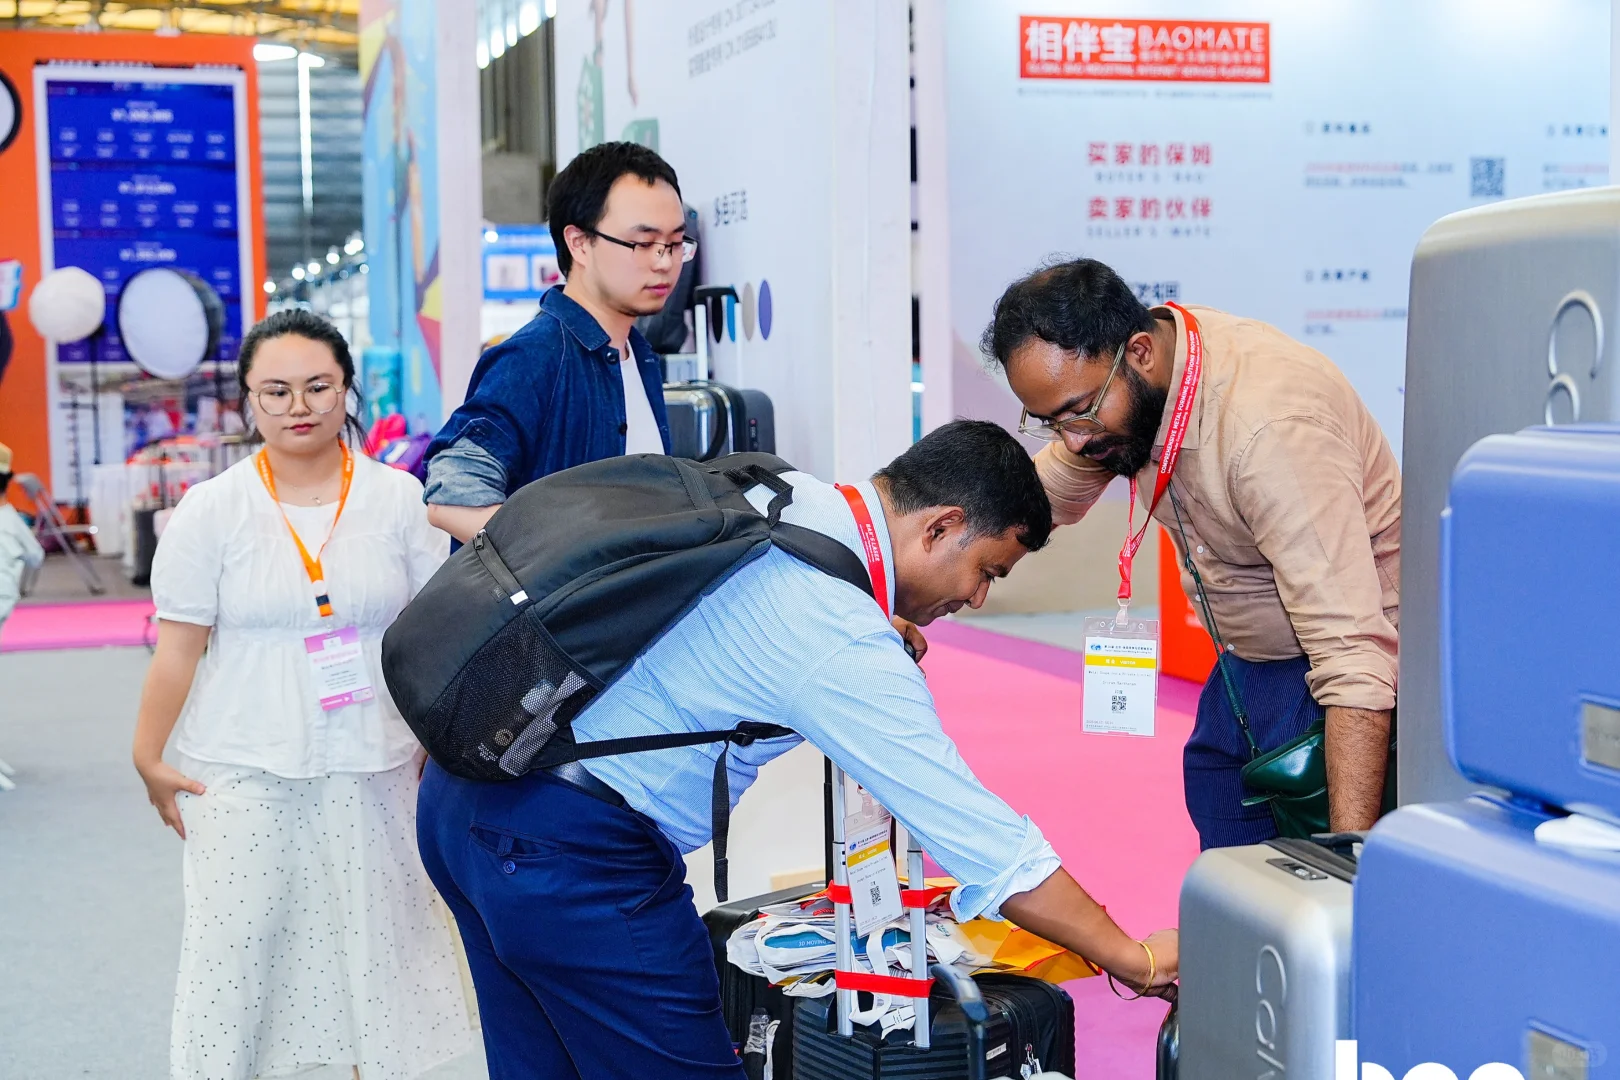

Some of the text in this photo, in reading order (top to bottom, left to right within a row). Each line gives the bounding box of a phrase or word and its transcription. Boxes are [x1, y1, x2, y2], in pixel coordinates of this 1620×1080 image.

[1025, 20, 1136, 62] 相伴宝
[1138, 25, 1265, 51] BAOMATE
[1089, 143, 1211, 165] 买家的保姆
[1089, 197, 1211, 219] 卖家的伙伴
[1161, 430, 1176, 473] COMPREHENSIVE
[1173, 412, 1181, 429] METAL
[1178, 385, 1188, 411] FORMING
[1185, 354, 1194, 385] SOLUTIONS
[871, 542, 881, 561] LASER
